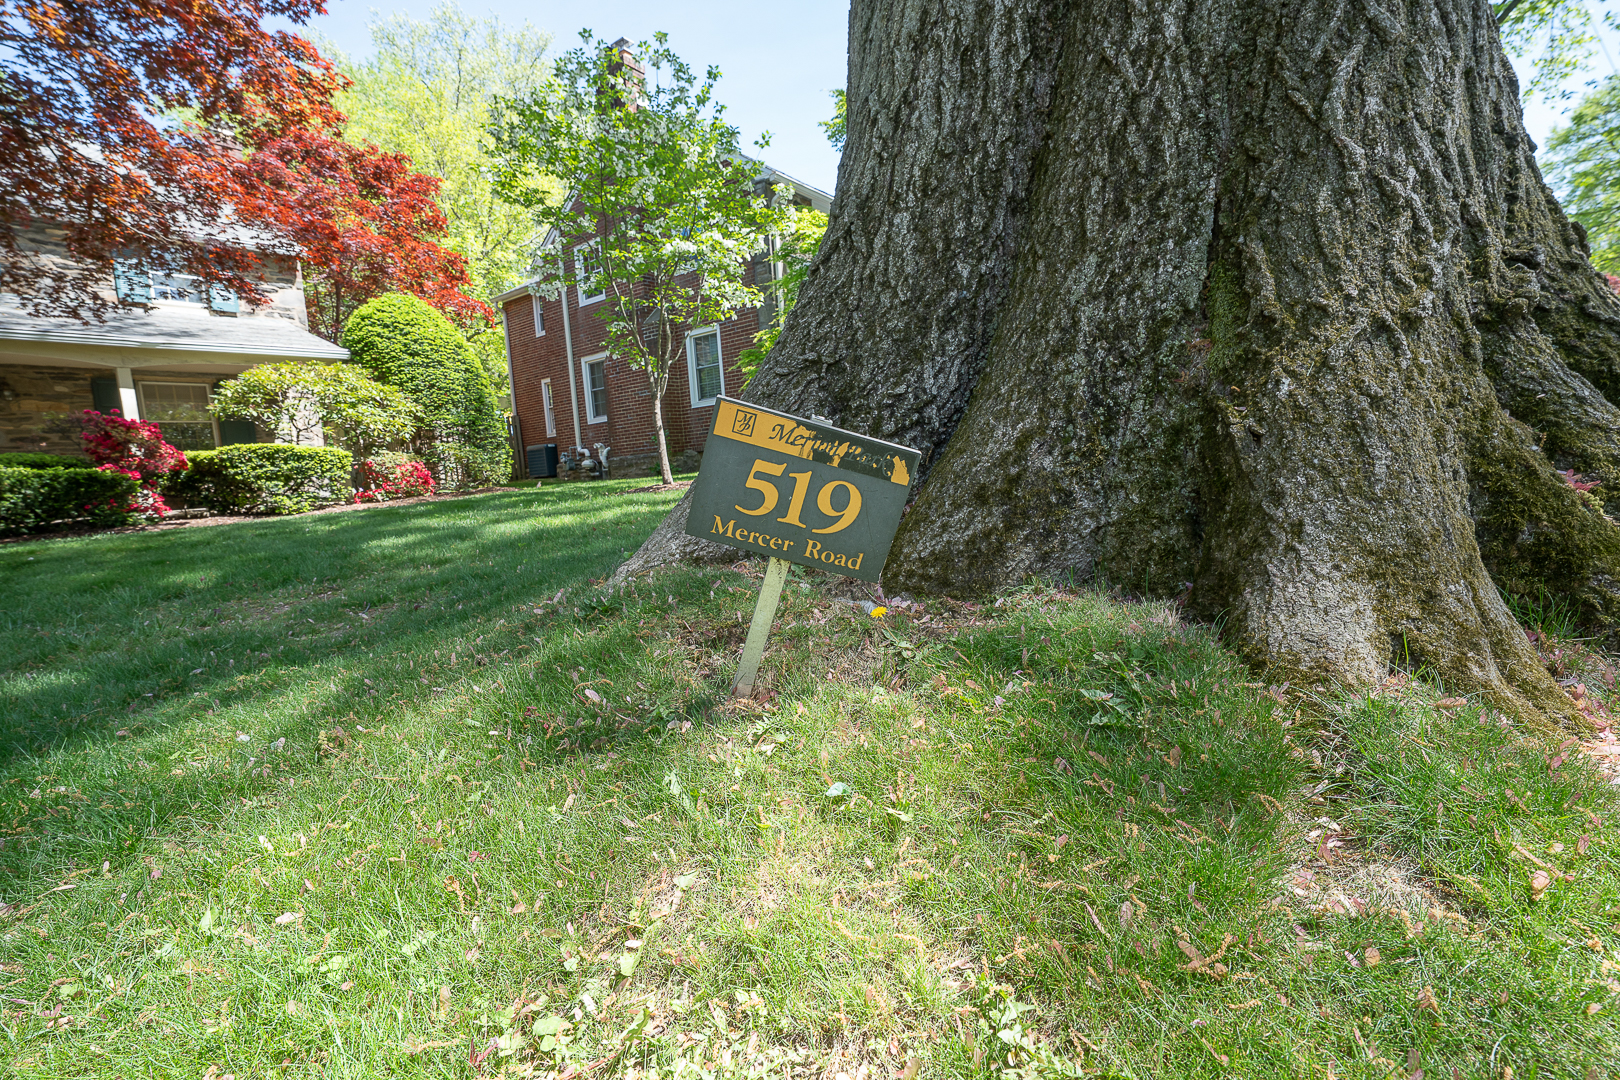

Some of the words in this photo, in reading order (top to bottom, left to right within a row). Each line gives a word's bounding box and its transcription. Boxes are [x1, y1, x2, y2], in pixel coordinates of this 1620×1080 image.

[769, 423, 840, 457] Merion
[844, 444, 894, 477] Park
[734, 458, 862, 534] 519
[710, 514, 794, 552] Mercer
[803, 538, 864, 570] Road
